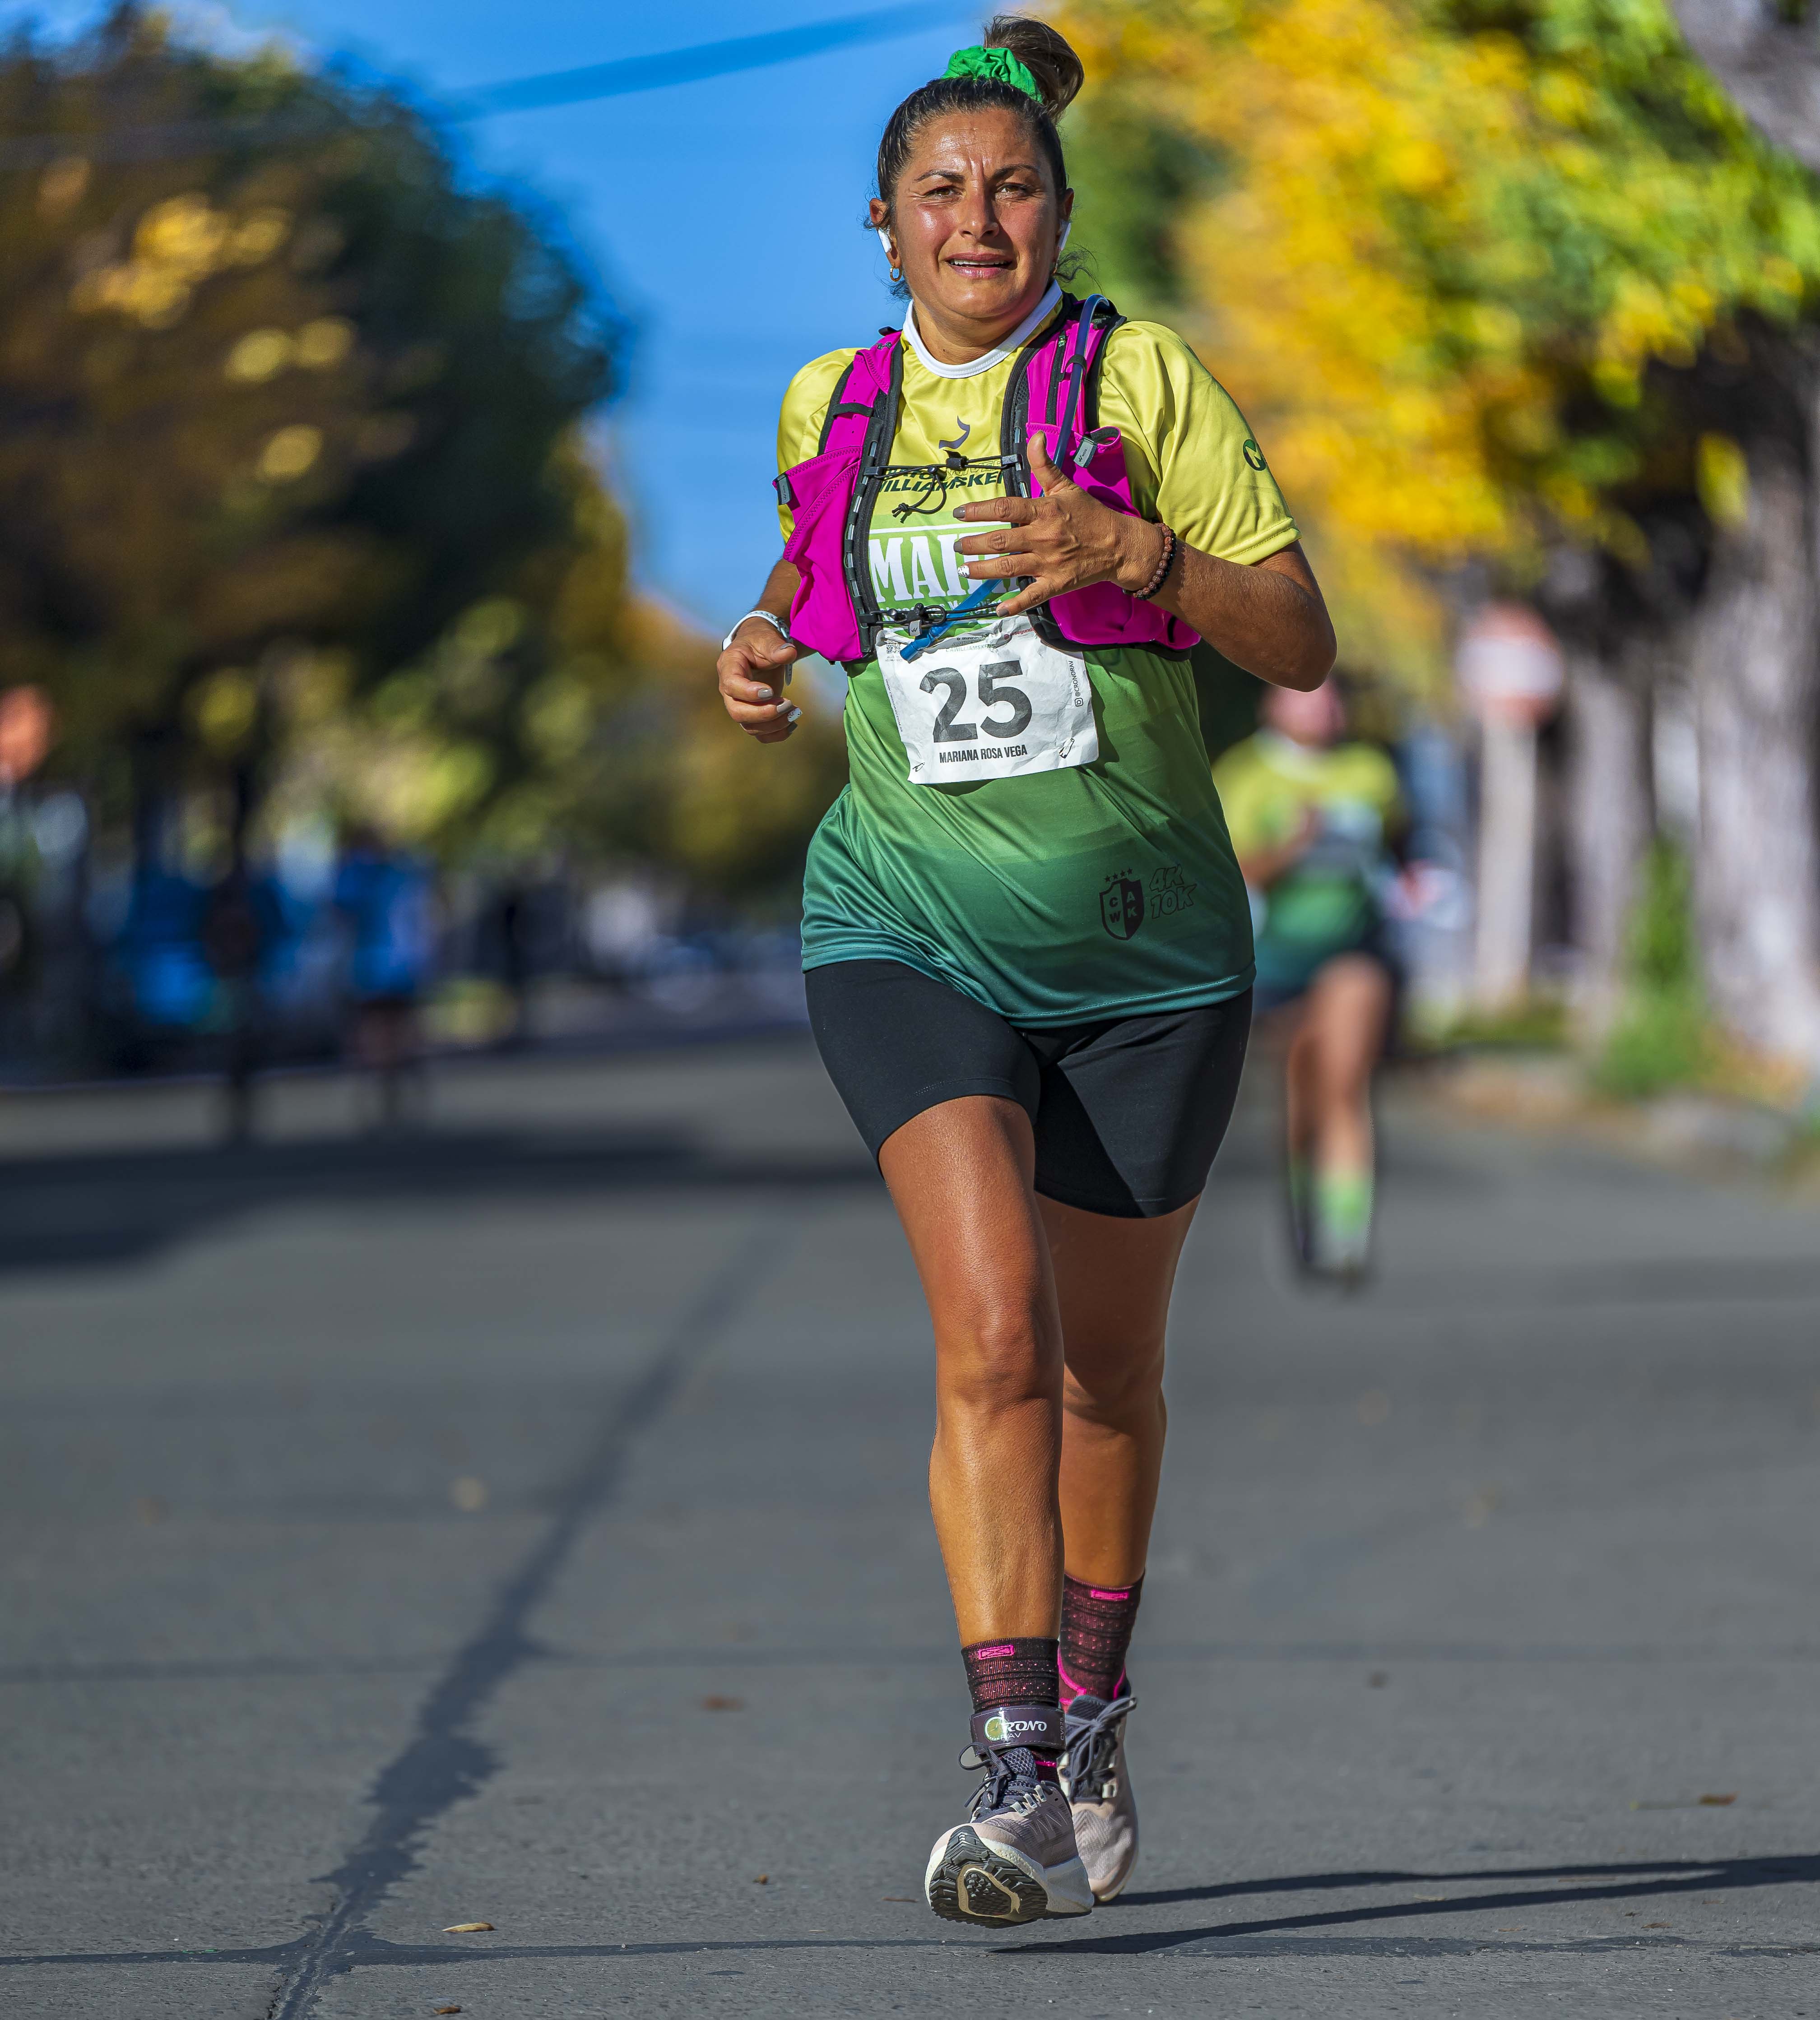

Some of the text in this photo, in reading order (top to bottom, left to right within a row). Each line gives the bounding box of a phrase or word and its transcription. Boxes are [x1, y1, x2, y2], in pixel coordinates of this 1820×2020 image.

[1068, 661, 1081, 696] @CRONORAV
[919, 660, 1032, 743] 25
[939, 744, 1028, 763] MARIANA ROSA VEGA
[1149, 863, 1184, 892] 4K
[1150, 884, 1197, 919] 10K
